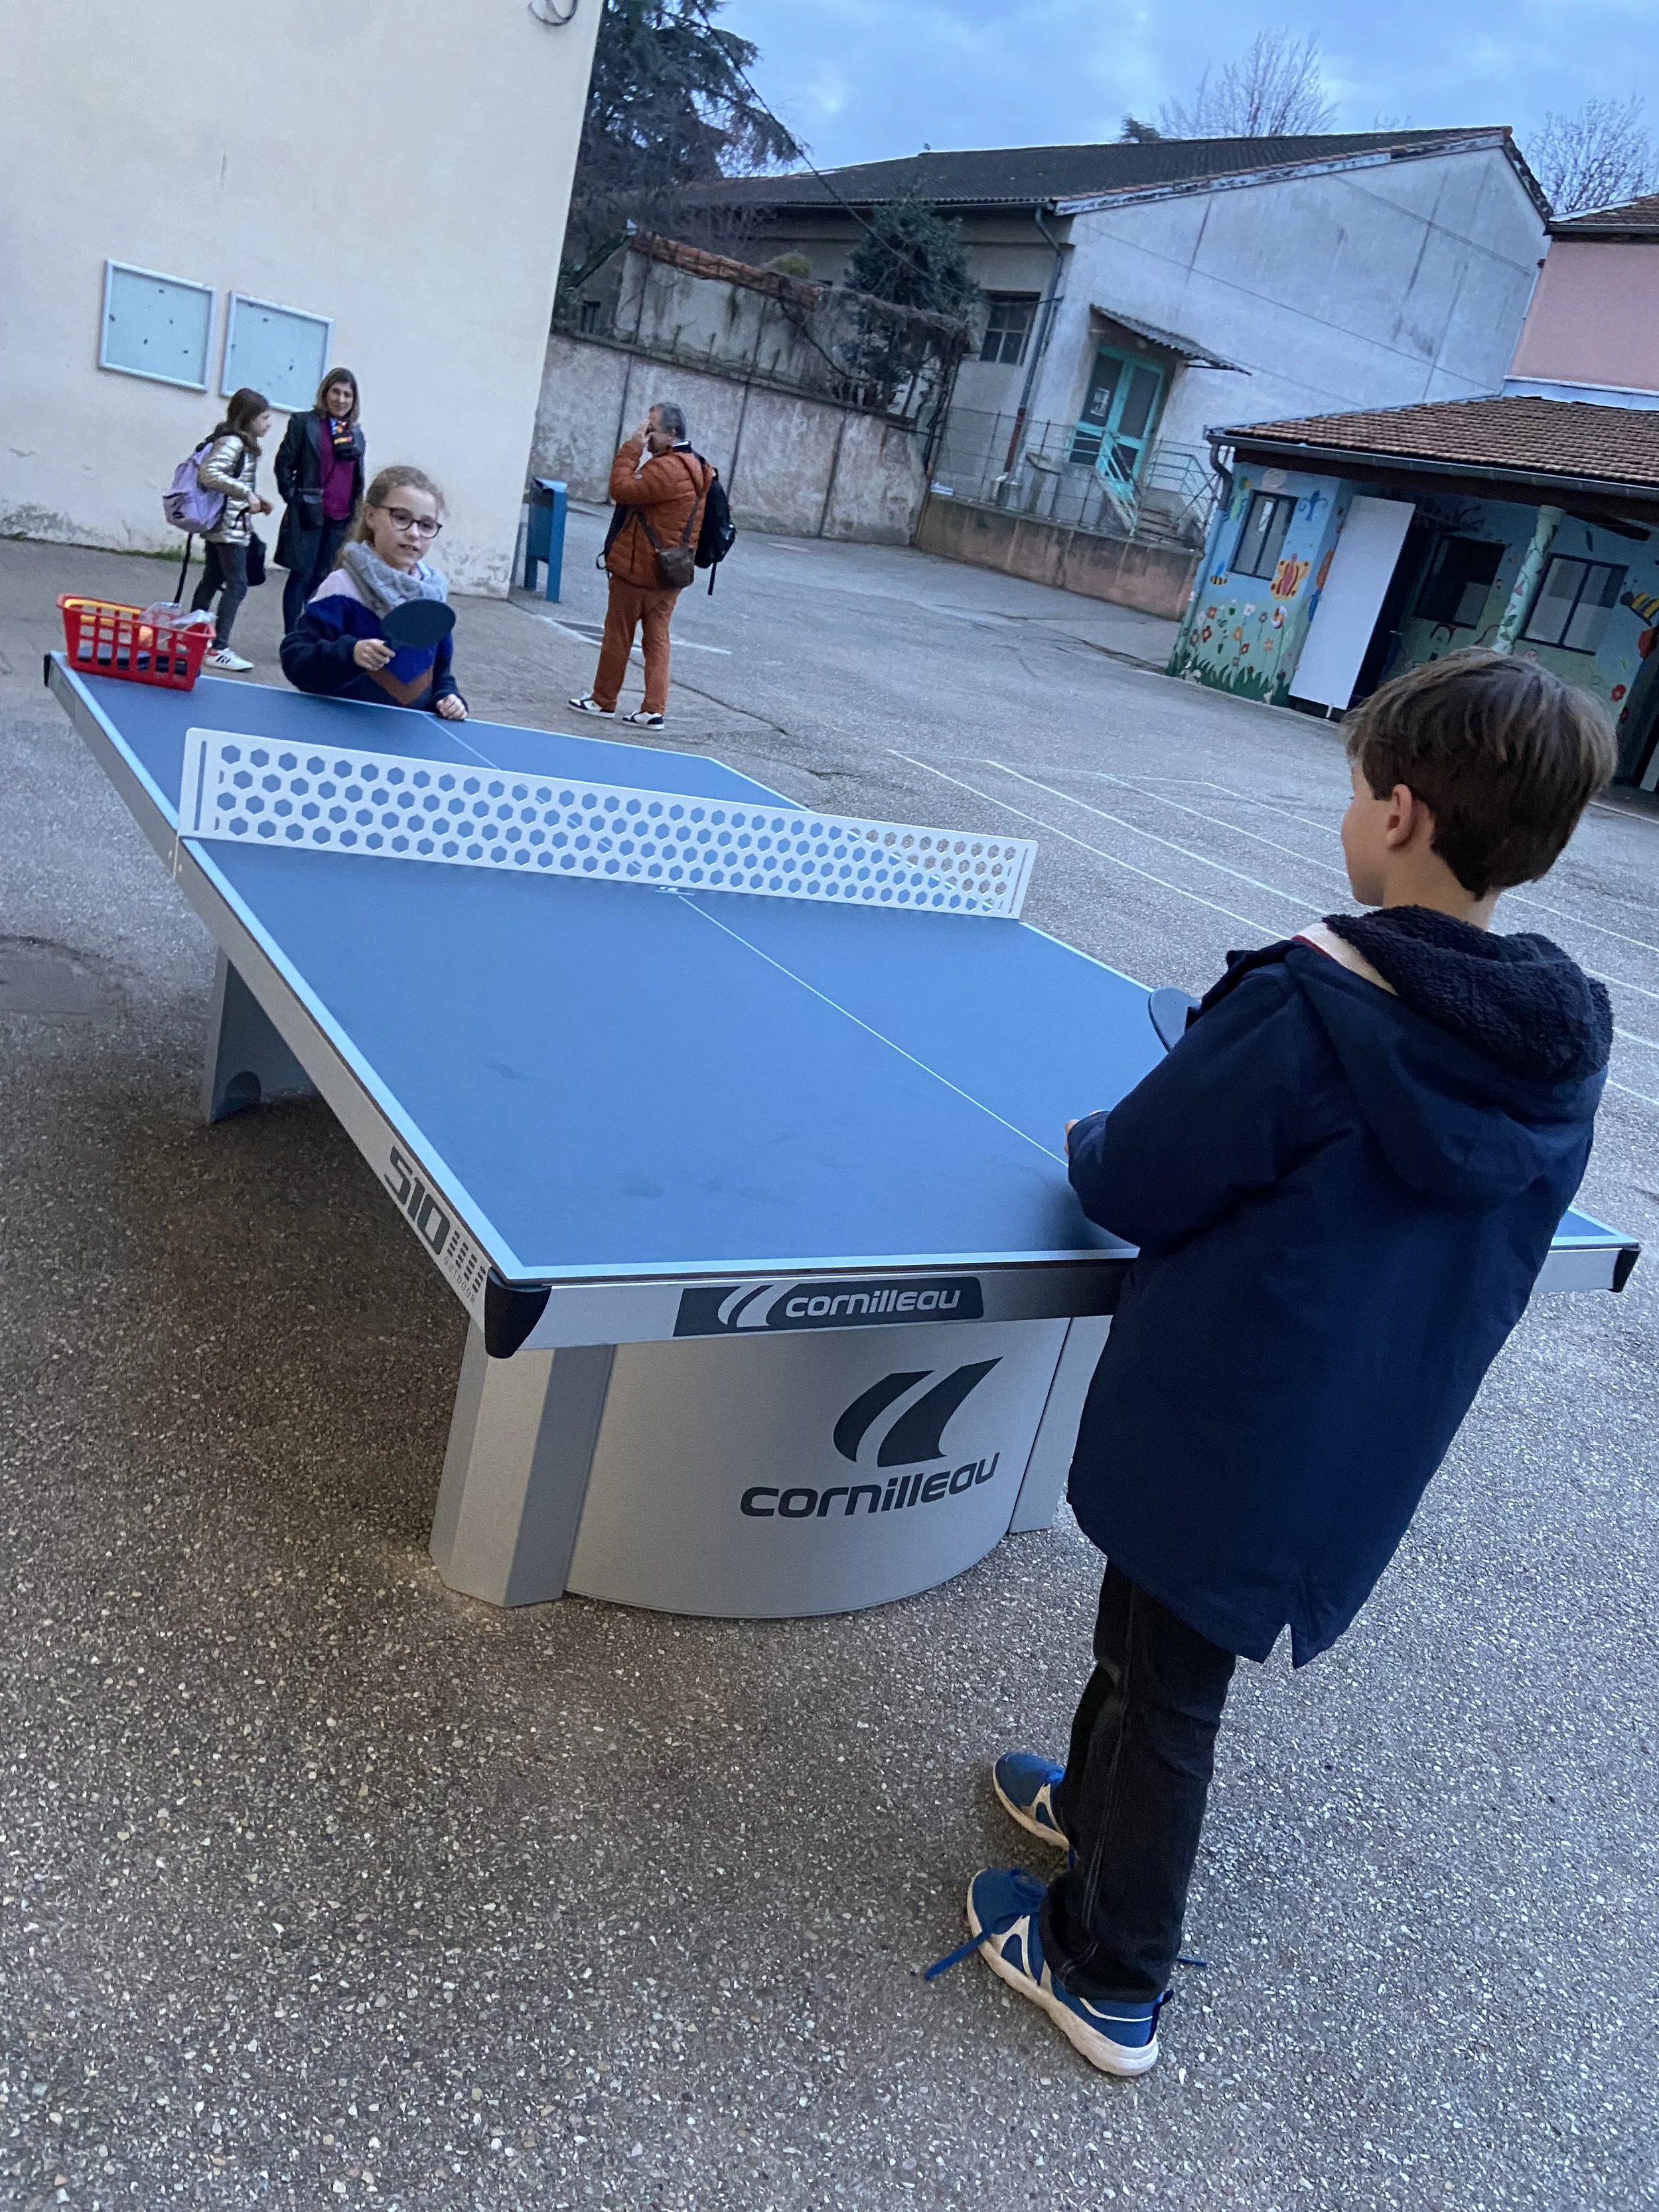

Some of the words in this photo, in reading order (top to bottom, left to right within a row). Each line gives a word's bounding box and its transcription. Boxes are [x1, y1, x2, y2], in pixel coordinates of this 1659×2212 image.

[384, 1145, 451, 1255] 510
[444, 1256, 475, 1303] OUTDOOR
[785, 1290, 962, 1317] cornilleau
[740, 1452, 1000, 1518] cornilleau
